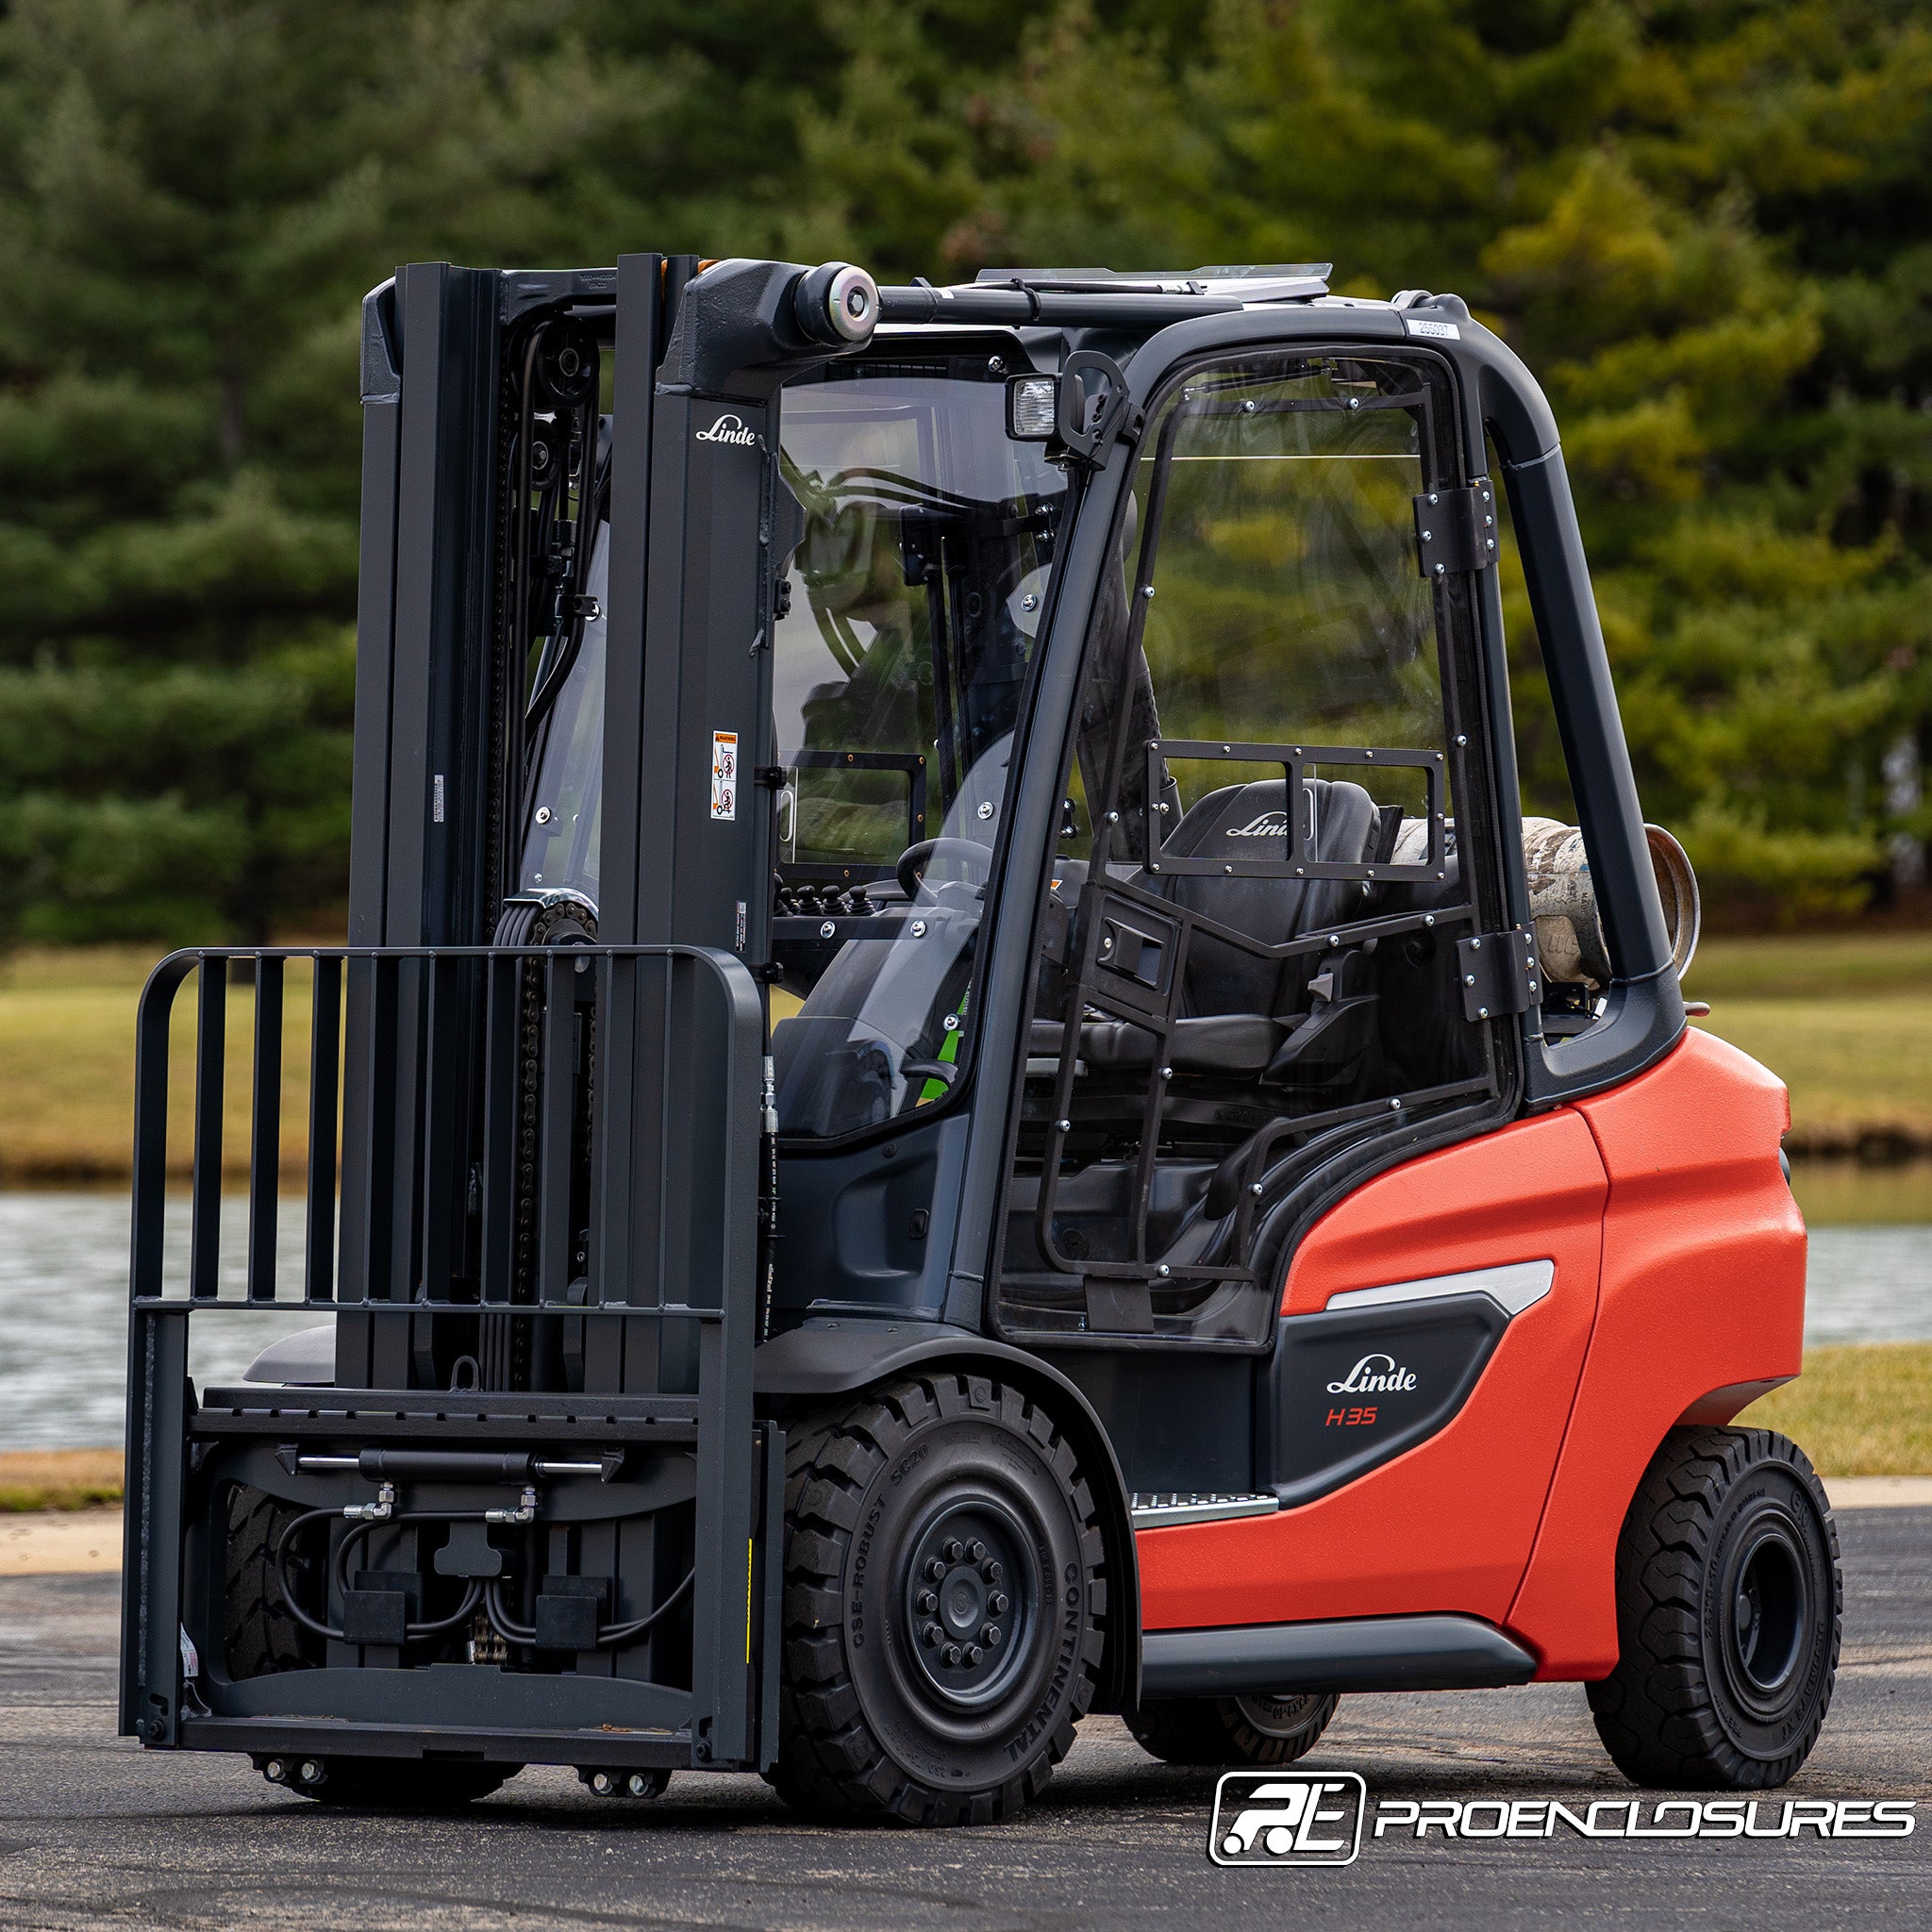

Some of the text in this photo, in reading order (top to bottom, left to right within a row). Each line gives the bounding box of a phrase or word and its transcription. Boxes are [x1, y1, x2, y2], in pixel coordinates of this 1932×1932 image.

[695, 414, 756, 446] Linde
[1326, 1353, 1417, 1394] Linde
[1002, 1562, 1078, 1763] CONTINENTAL
